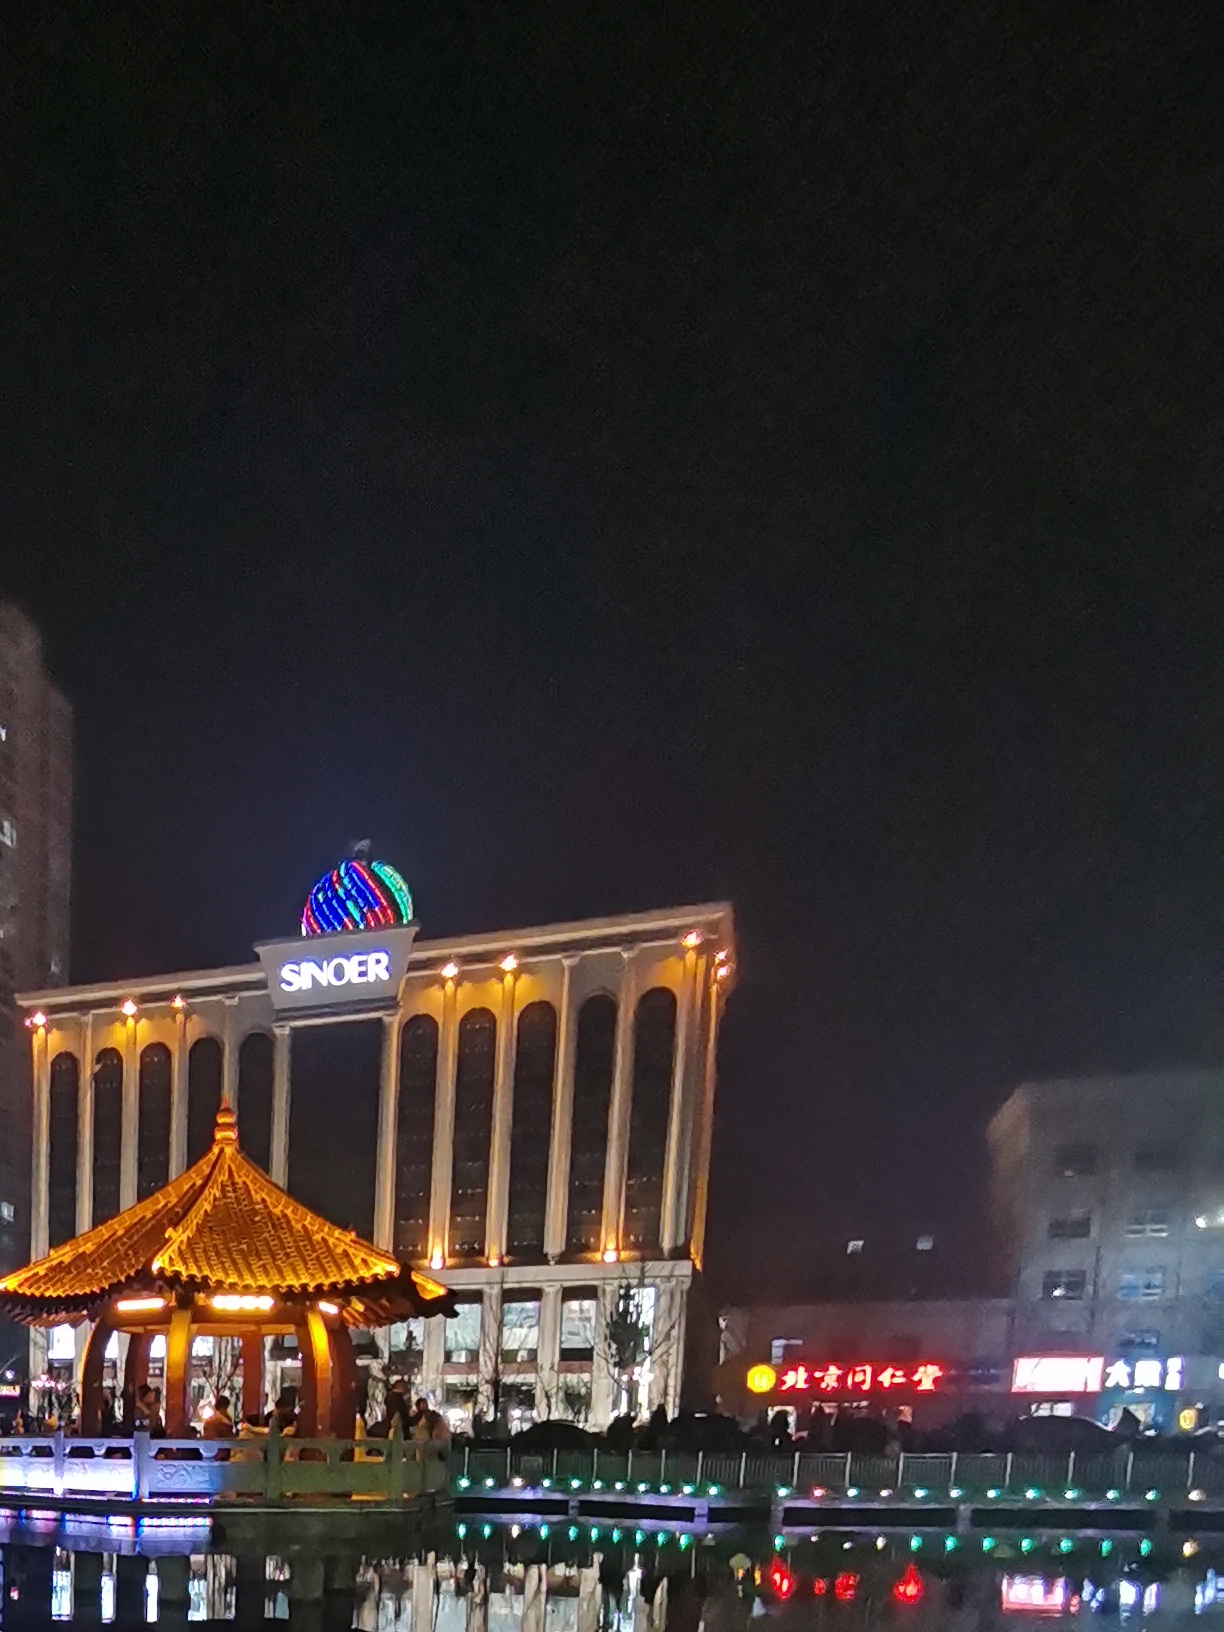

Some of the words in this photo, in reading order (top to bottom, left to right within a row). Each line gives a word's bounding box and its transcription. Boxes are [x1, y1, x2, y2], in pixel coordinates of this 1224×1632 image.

[279, 951, 390, 992] SINOER
[778, 1363, 944, 1392] 北京同仁堂
